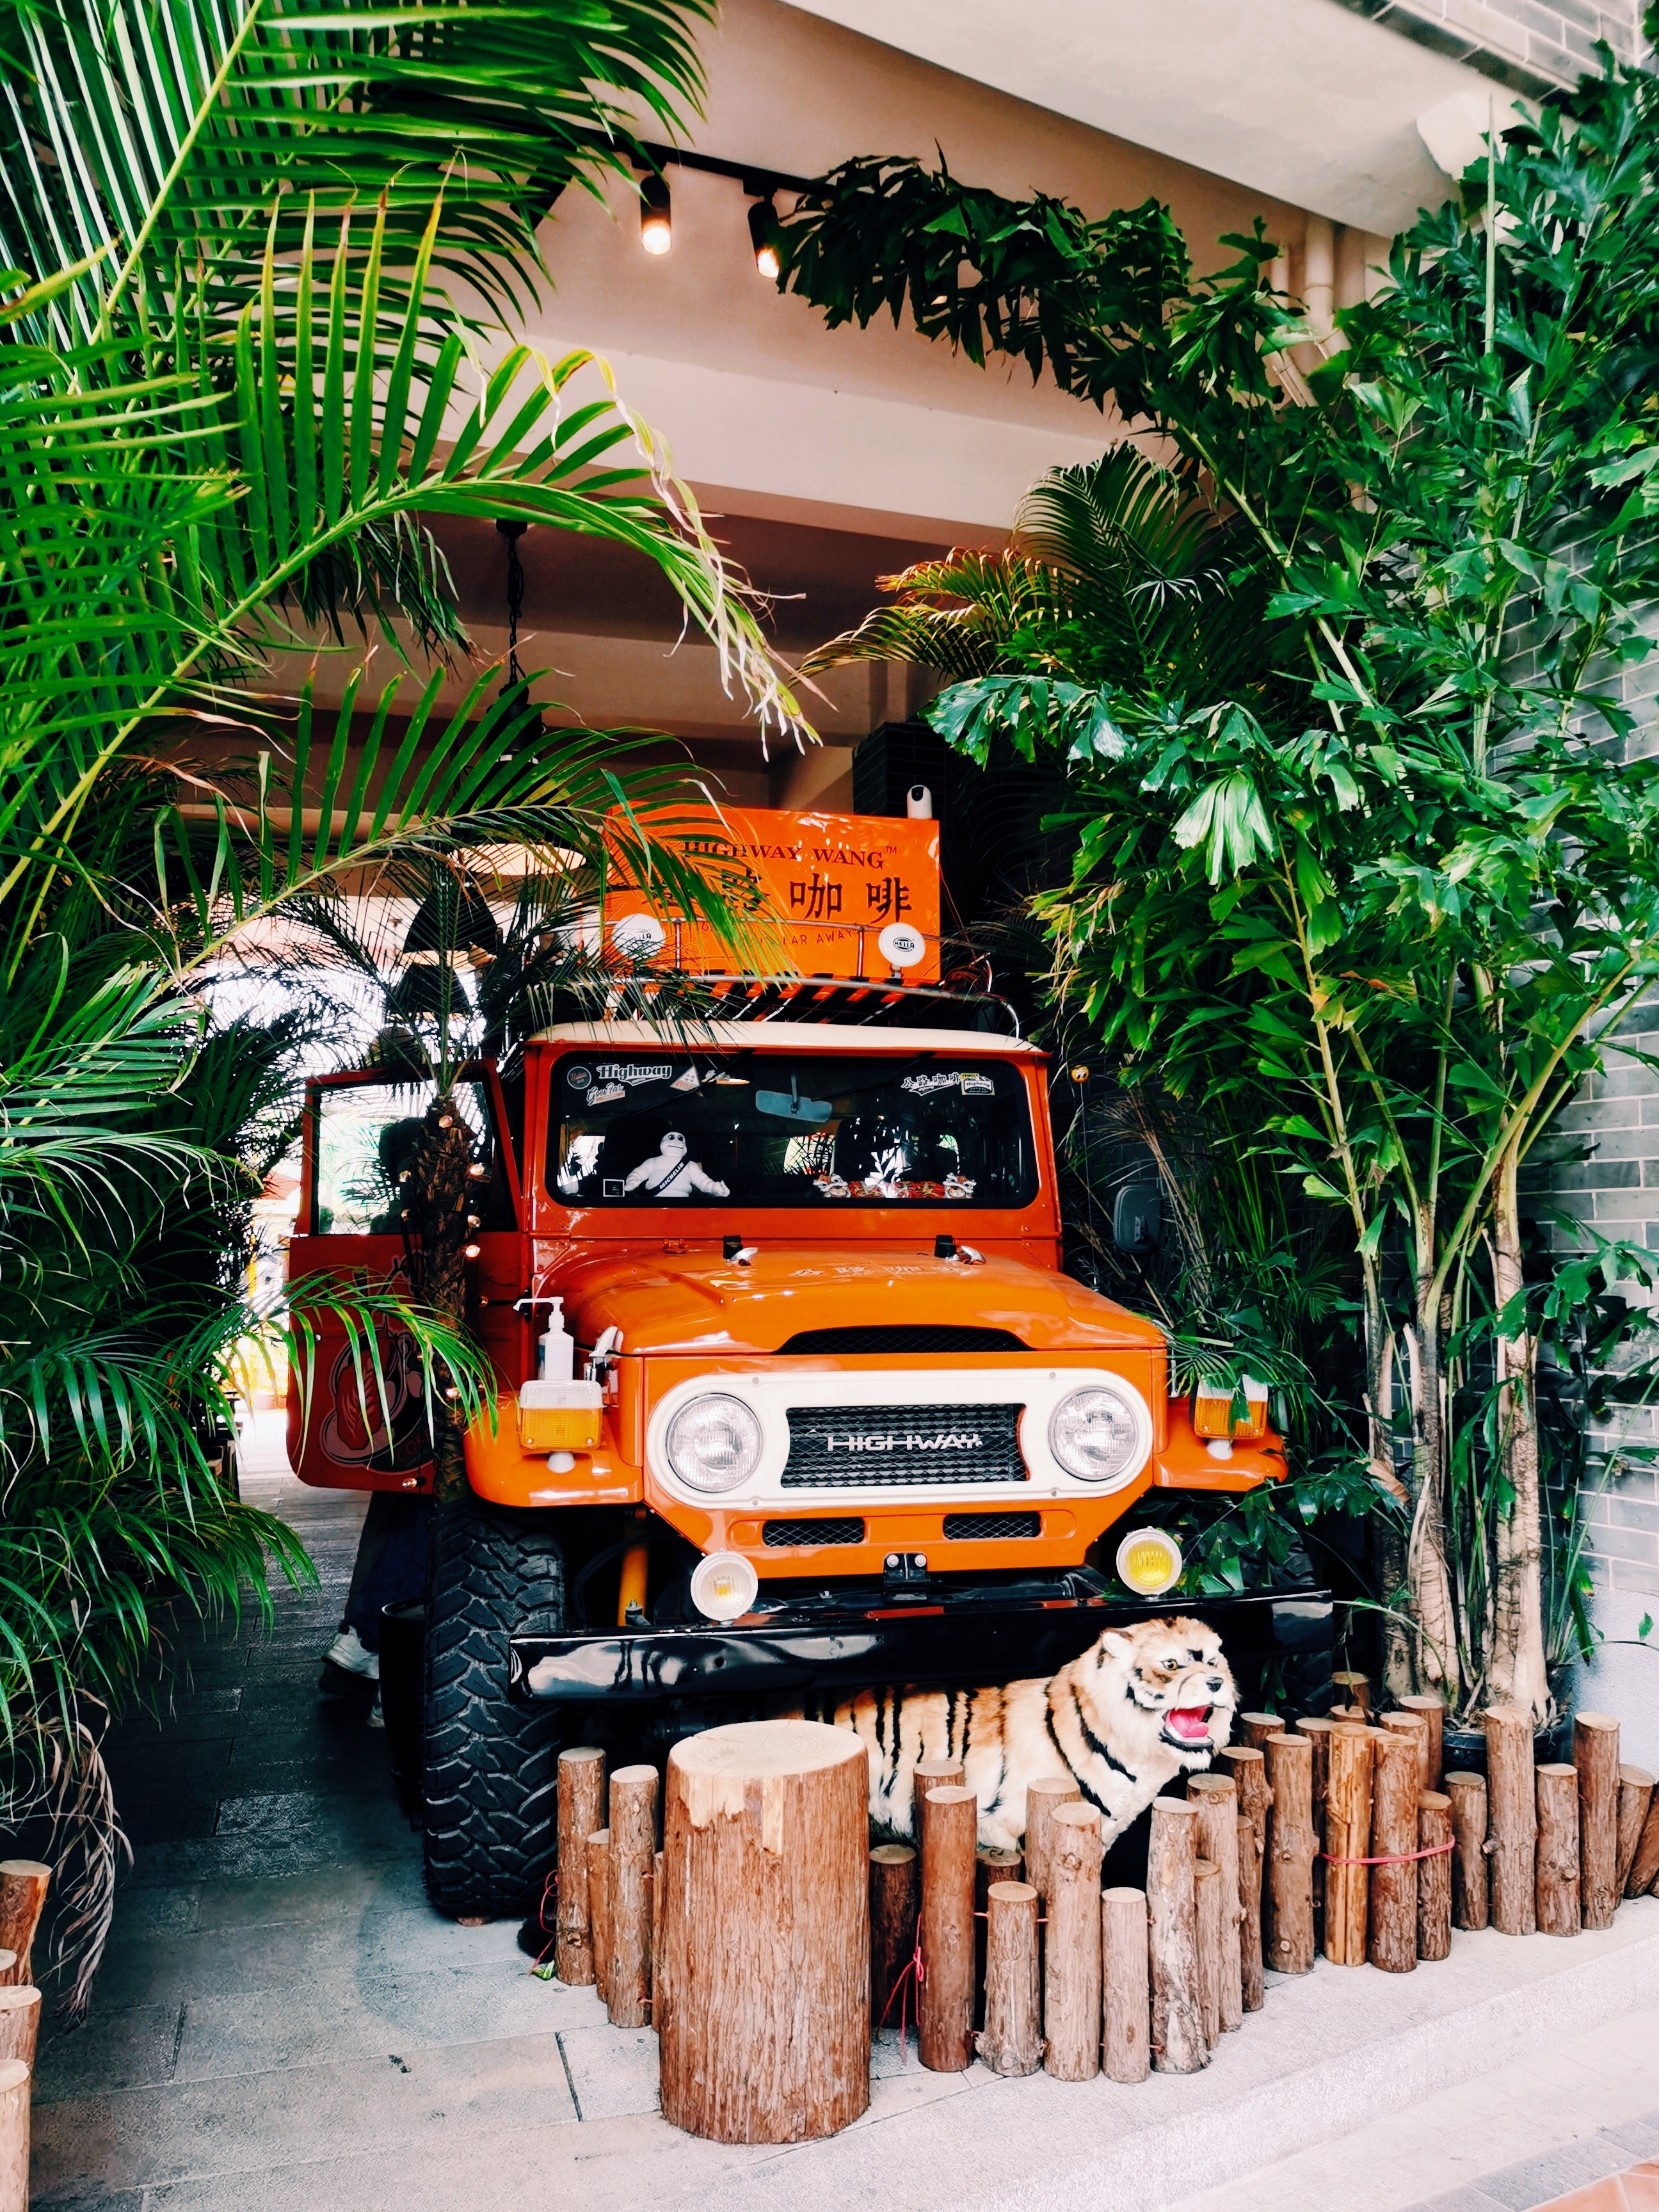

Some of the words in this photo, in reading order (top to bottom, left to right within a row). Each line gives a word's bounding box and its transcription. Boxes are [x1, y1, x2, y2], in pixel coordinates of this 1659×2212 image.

[812, 847, 885, 870] WANG
[816, 929, 853, 944] AWAY
[597, 1065, 671, 1080] Highway
[901, 1073, 960, 1087] 公路咖啡
[586, 1086, 607, 1105] Goes
[659, 1162, 684, 1190] MICHELIN
[827, 1434, 979, 1452] HIGHWAY
